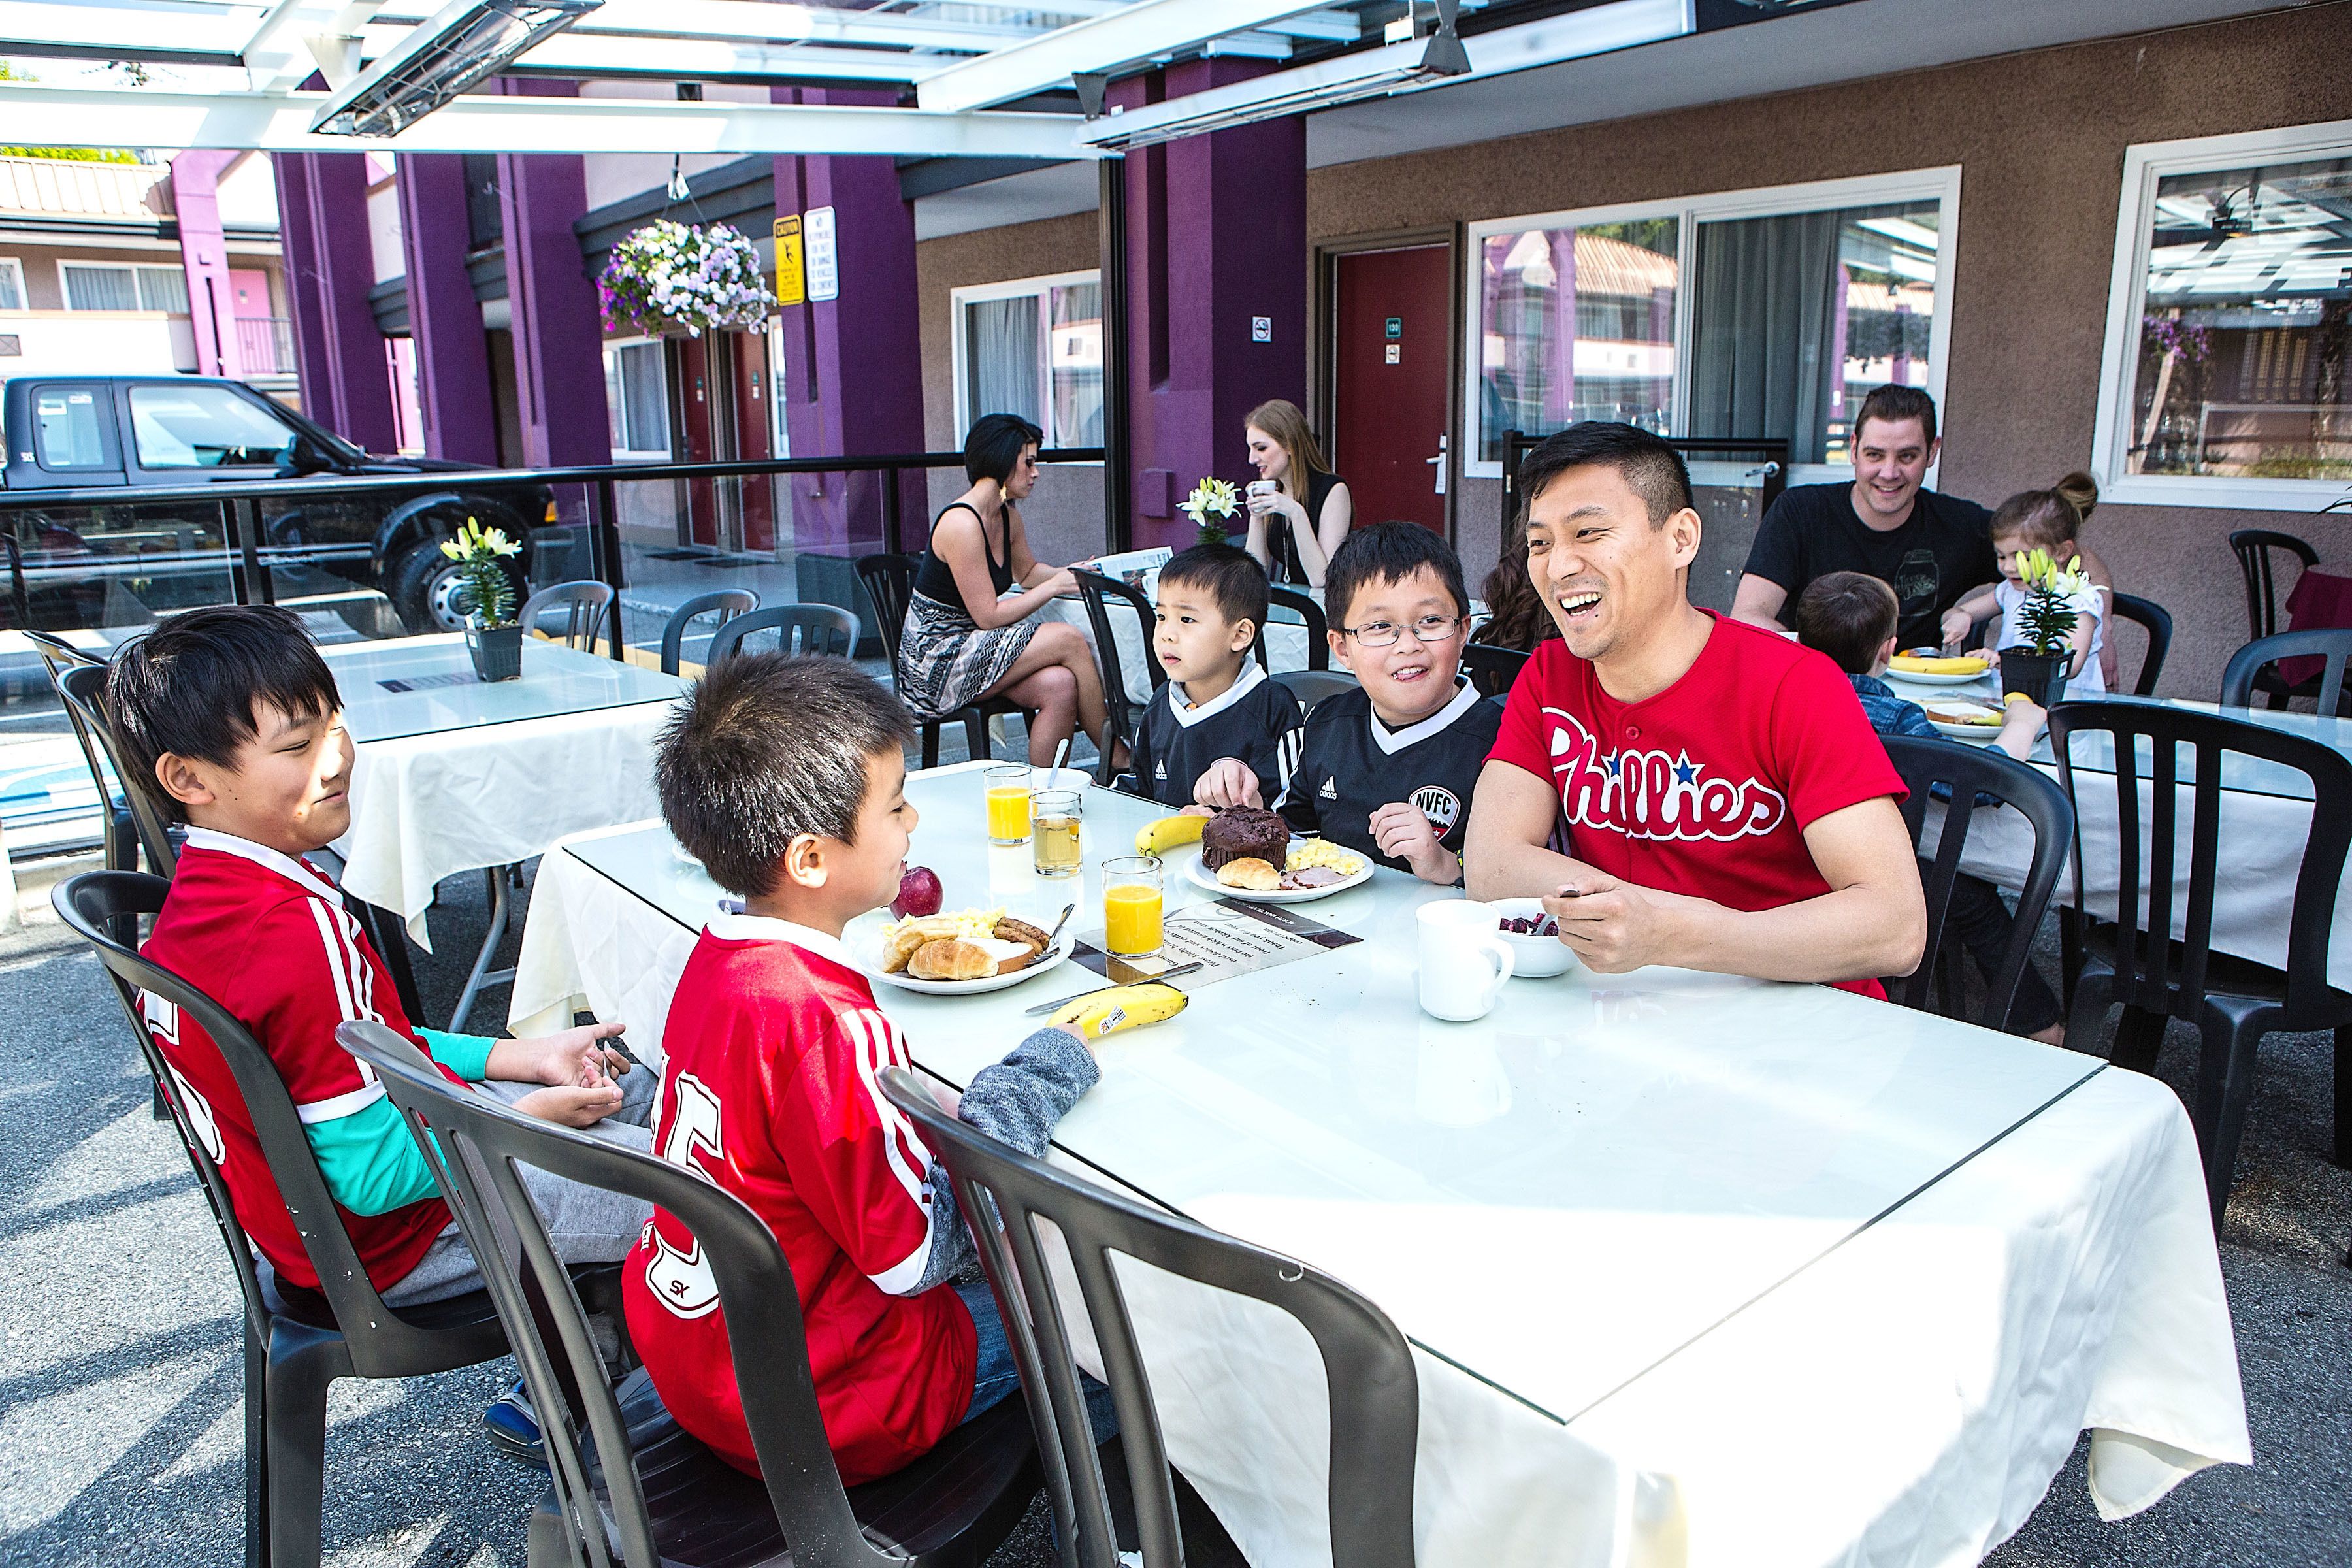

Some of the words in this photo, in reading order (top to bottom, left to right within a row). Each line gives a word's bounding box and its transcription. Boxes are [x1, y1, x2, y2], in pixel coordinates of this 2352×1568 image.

[777, 221, 798, 237] CAUTION
[1541, 706, 1786, 842] Phillies
[1319, 789, 1337, 800] adidas
[1416, 791, 1452, 815] NVFC
[1275, 915, 1296, 925] NORTH
[1183, 928, 1208, 939] located
[1207, 926, 1232, 938] kitchen
[1207, 937, 1227, 947] which
[1263, 938, 1286, 949] Thank
[1201, 945, 1221, 955] dishes
[1227, 945, 1242, 954] bins
[1251, 945, 1271, 954] front
[1198, 957, 1220, 967] Please
[1218, 955, 1237, 963] used
